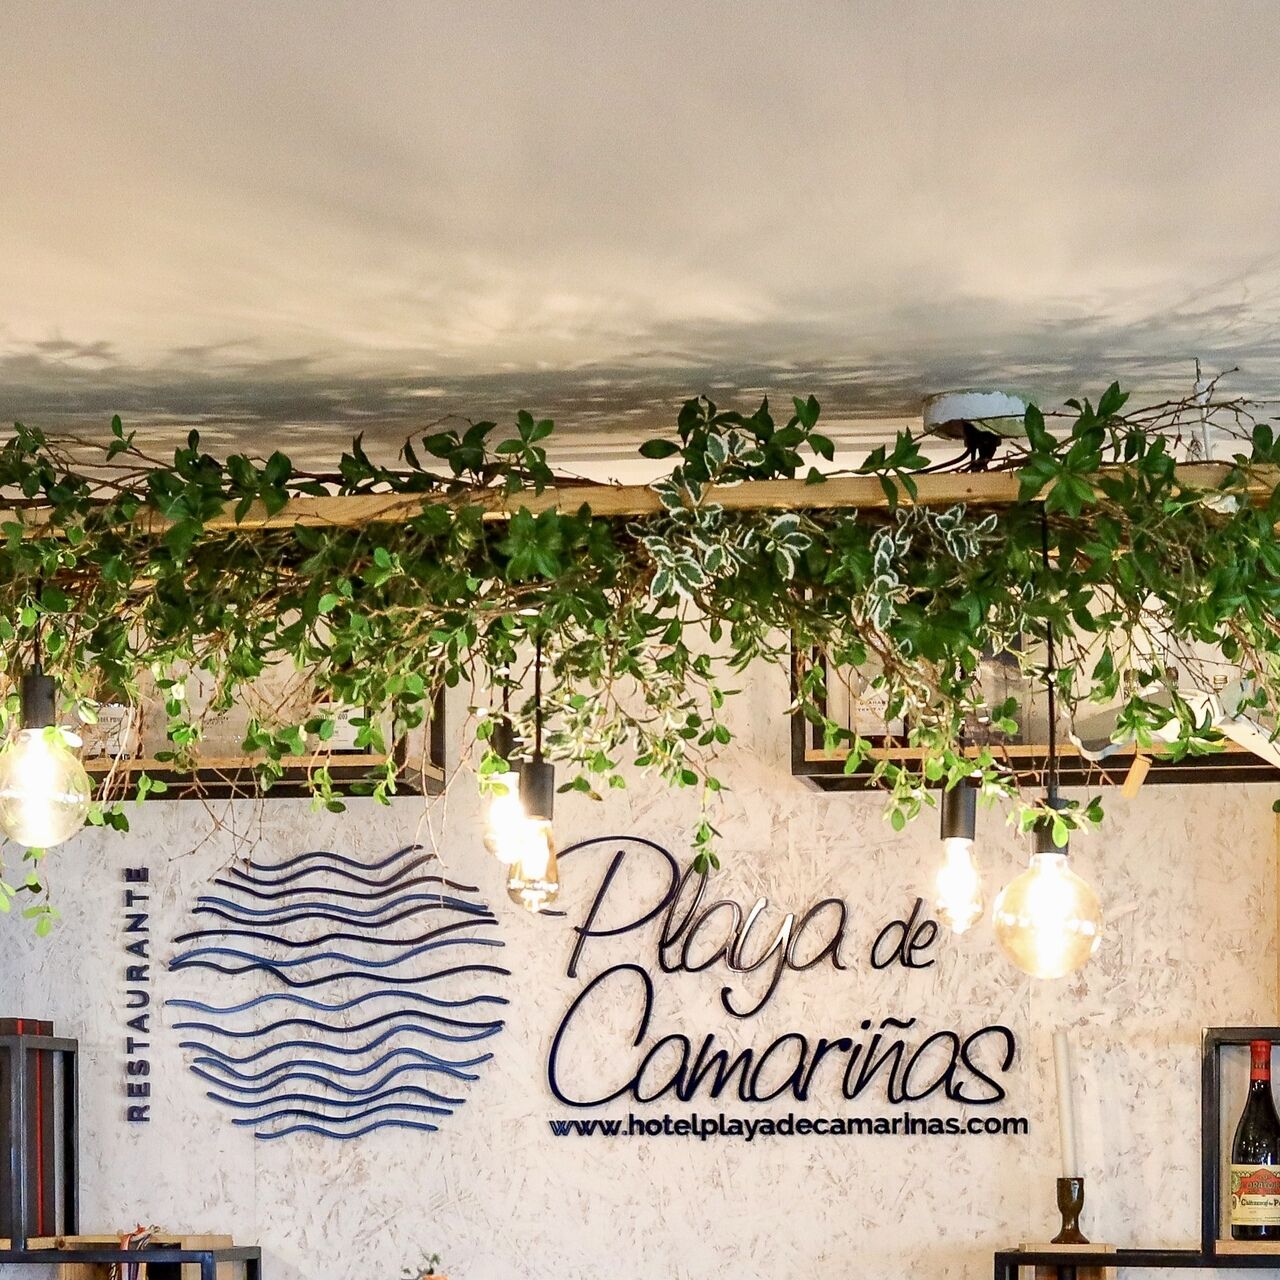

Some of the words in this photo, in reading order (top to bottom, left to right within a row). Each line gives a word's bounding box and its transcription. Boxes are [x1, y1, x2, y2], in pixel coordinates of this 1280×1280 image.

[125, 867, 150, 1122] RESTAURANTE
[539, 835, 847, 1018] Playa
[870, 897, 939, 969] de
[547, 963, 1016, 1108] Camariñas
[549, 1112, 1030, 1141] www.hotelplayadecamarinas.com
